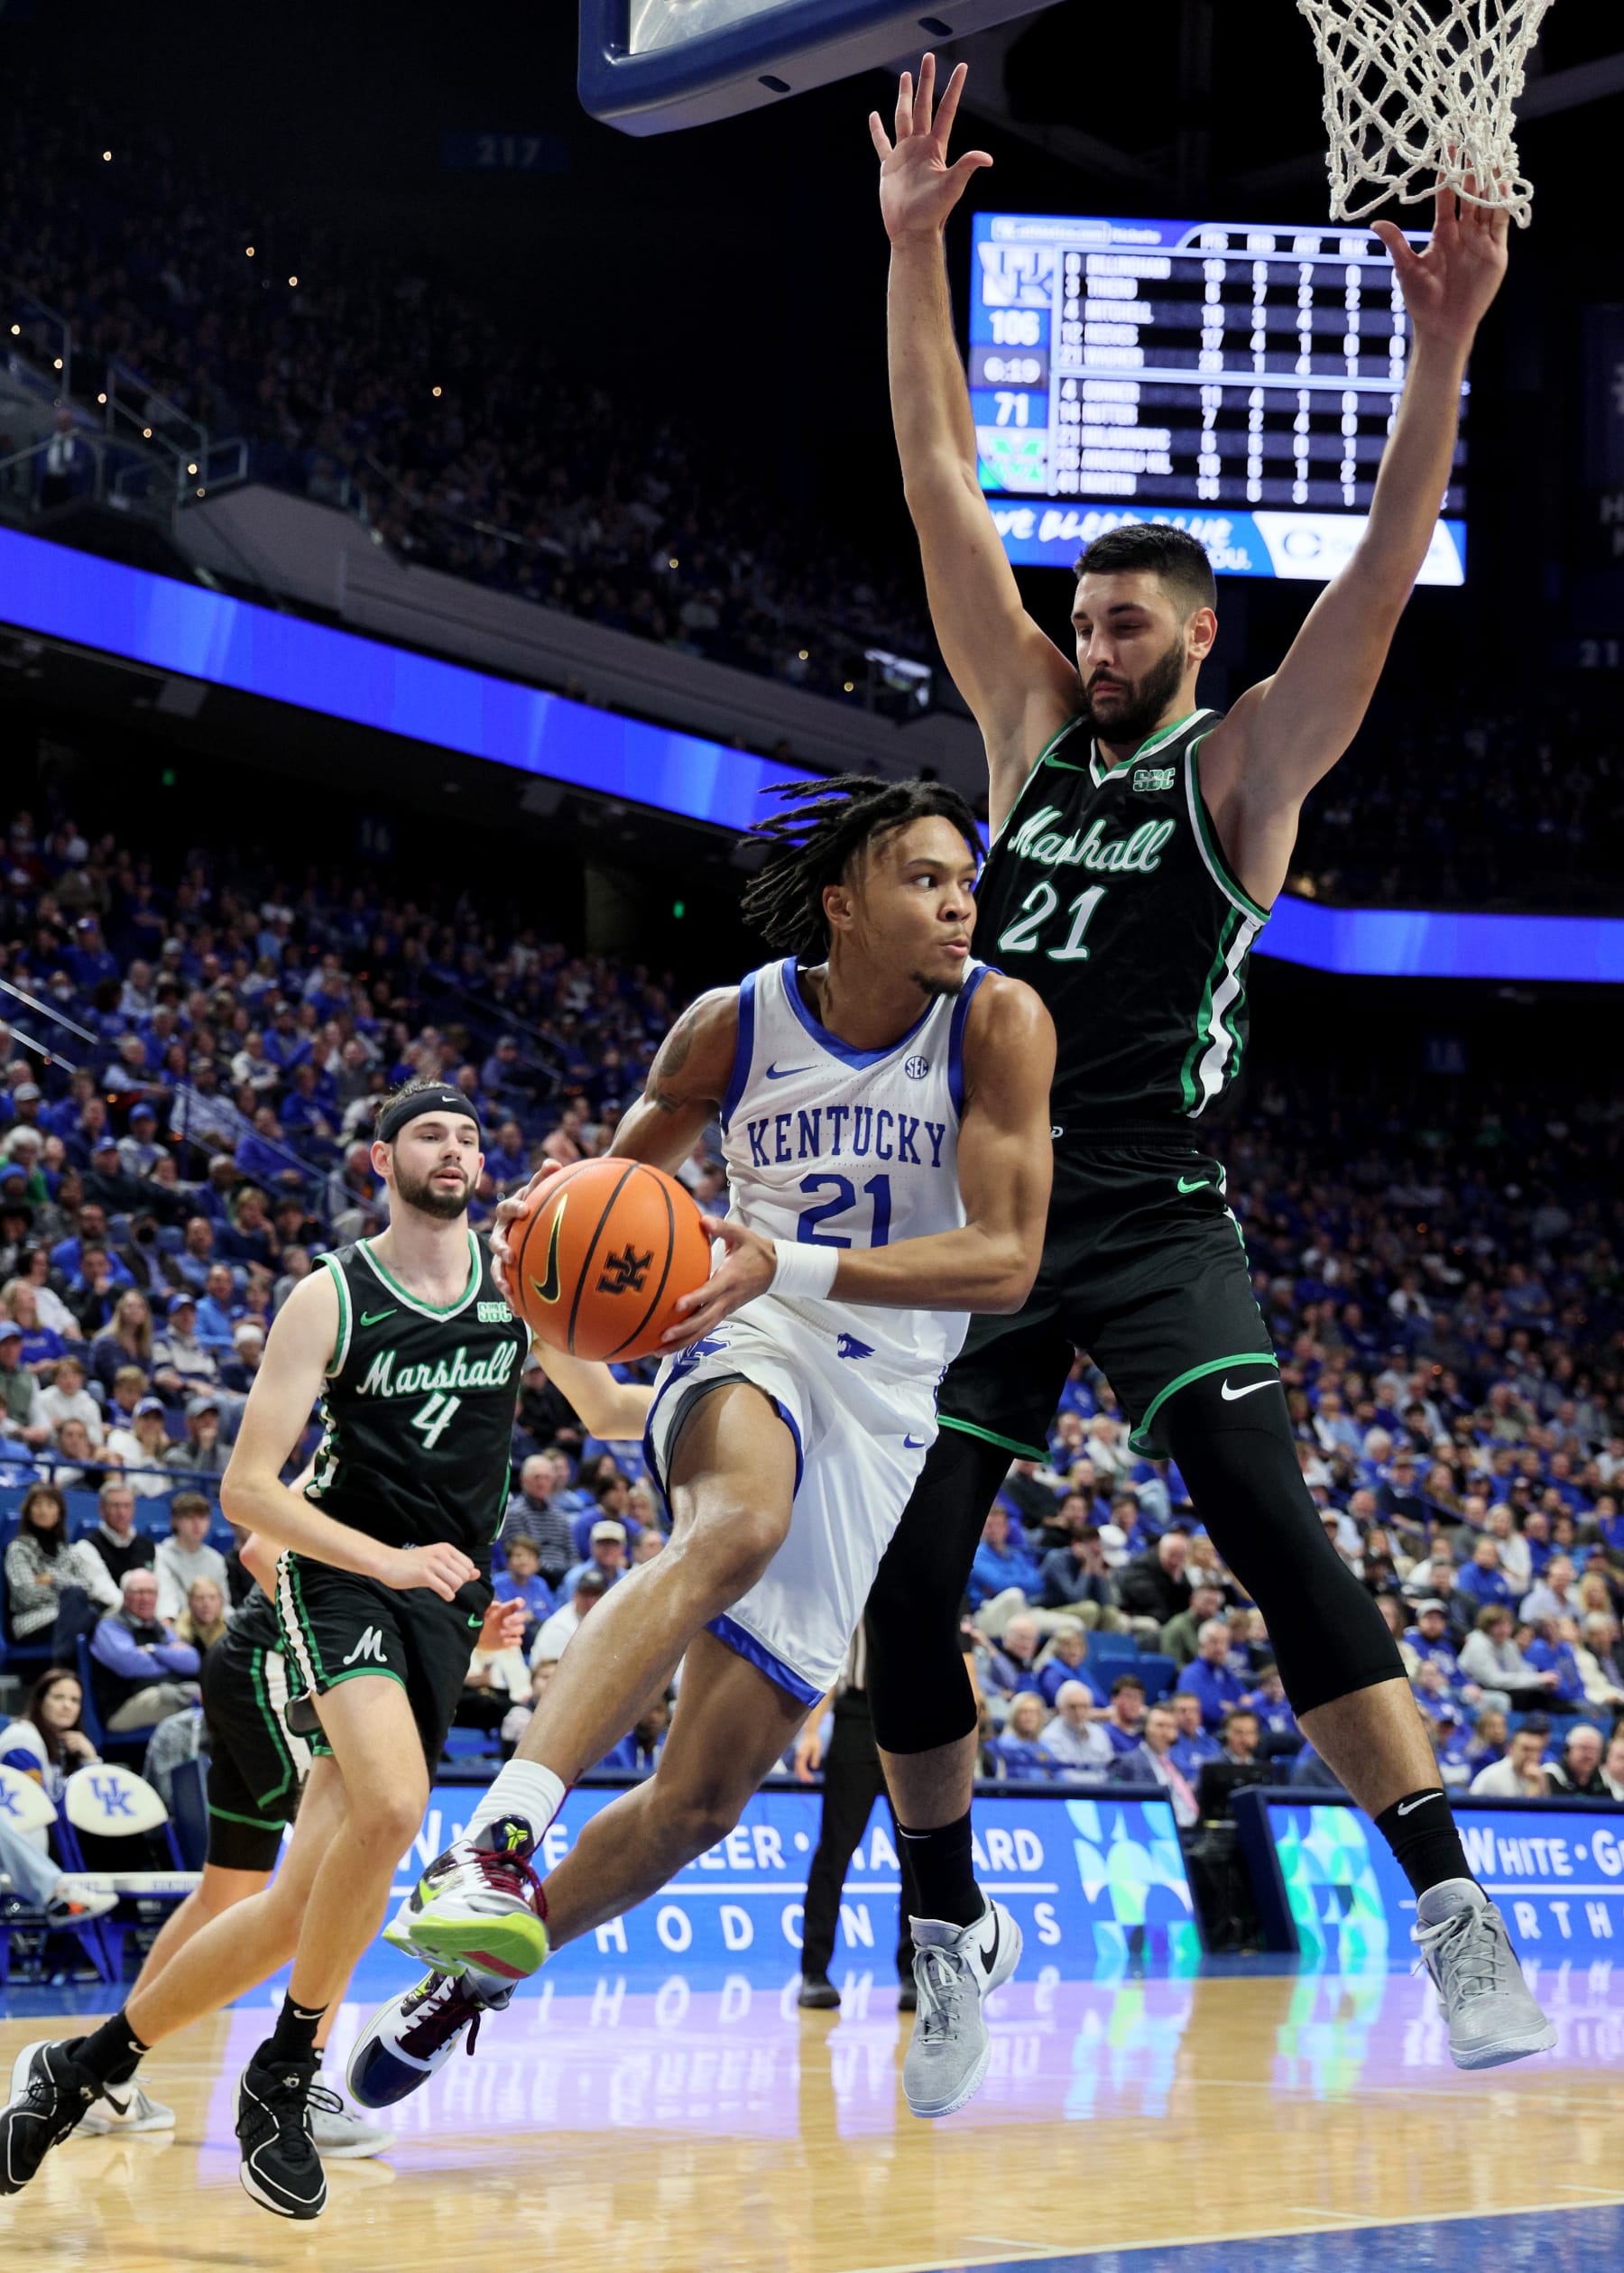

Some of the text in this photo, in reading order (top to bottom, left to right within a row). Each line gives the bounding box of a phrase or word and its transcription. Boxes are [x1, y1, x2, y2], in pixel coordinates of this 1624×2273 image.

[994, 392, 1029, 427] 71
[998, 881, 1108, 961] 21
[906, 1058, 928, 1078] SEC
[747, 1105, 946, 1168] KENTUCKY
[797, 1173, 891, 1249] 21
[595, 1243, 655, 1295] UK
[355, 1341, 518, 1397] Marshall
[410, 1390, 462, 1450] 4
[343, 1625, 388, 1665] M
[0, 1777, 23, 1816] K
[90, 1776, 137, 1817] UK
[1456, 1826, 1573, 1877] WHITE
[1513, 1901, 1614, 1940] RTH
